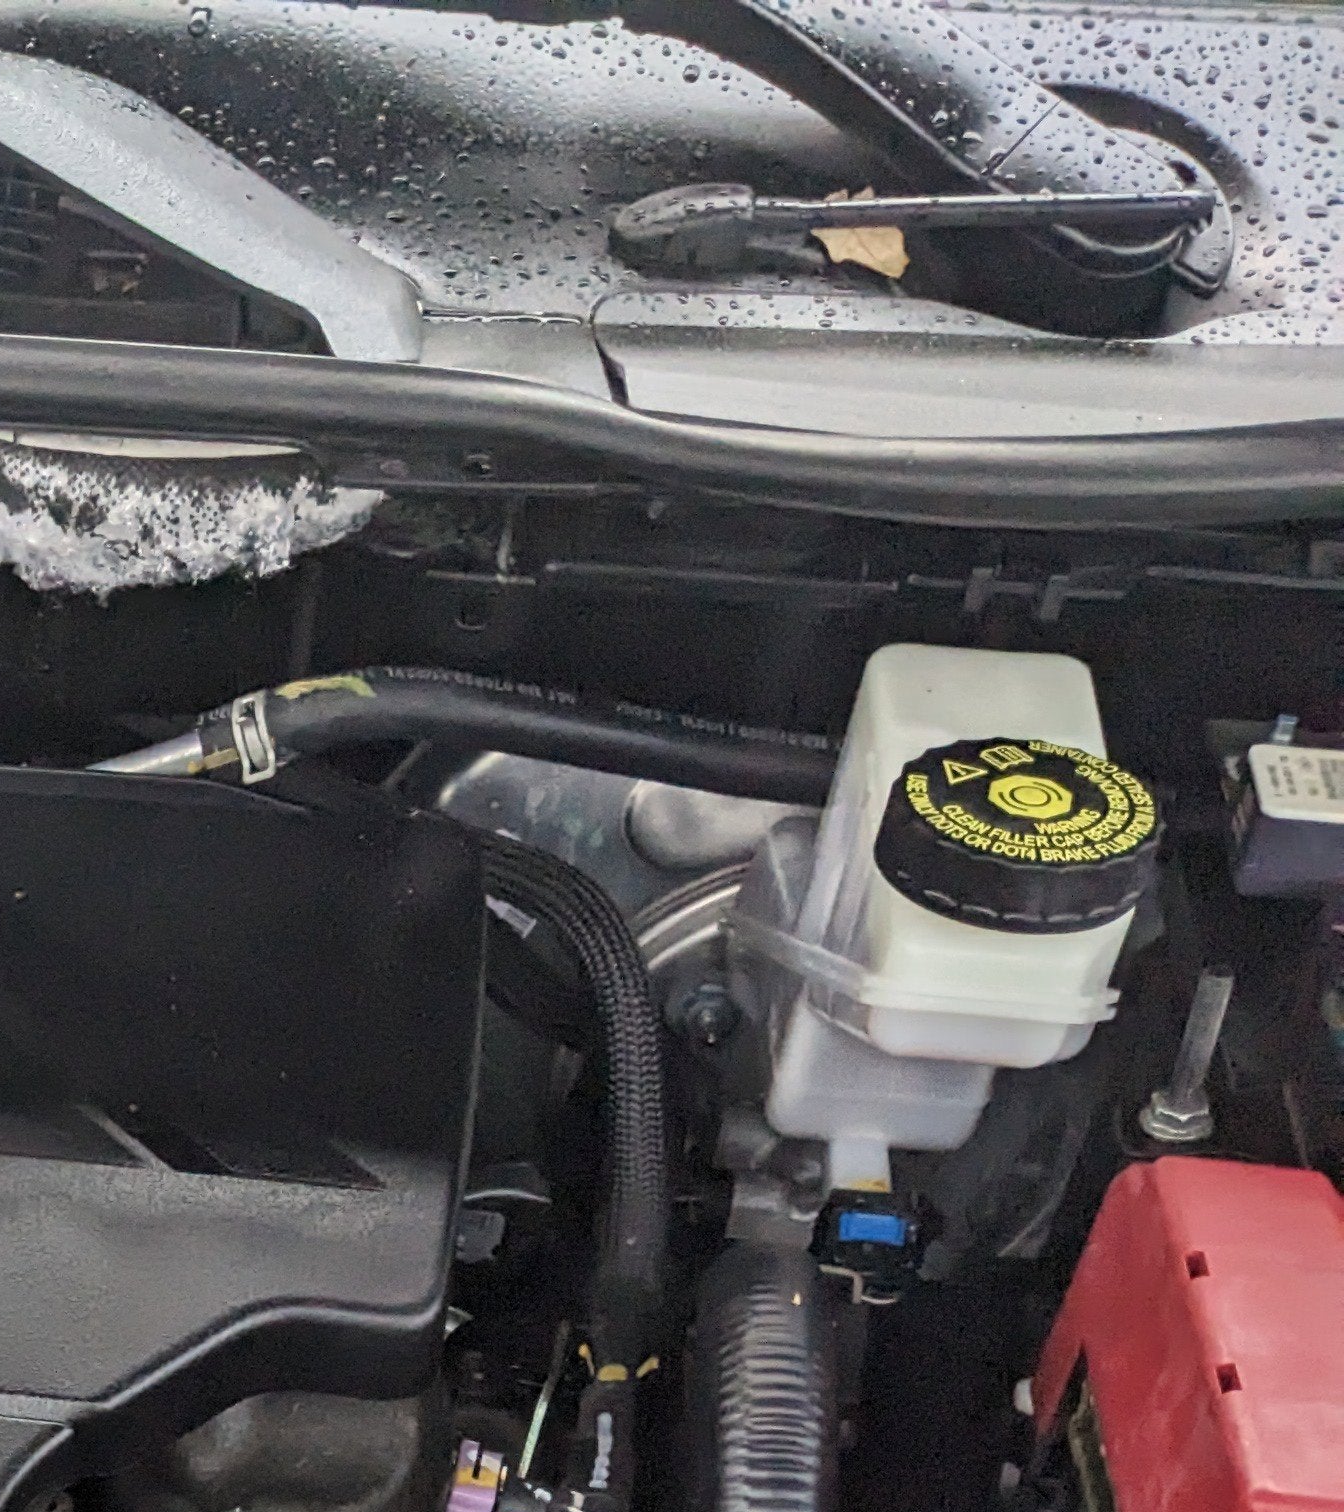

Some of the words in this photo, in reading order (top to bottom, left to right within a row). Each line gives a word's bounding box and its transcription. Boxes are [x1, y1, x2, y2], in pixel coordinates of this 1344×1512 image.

[1029, 741, 1119, 773] CONTAINER
[925, 813, 968, 839] DOT3
[942, 804, 992, 835] CLEAN
[988, 827, 1050, 848] FILLER
[1051, 833, 1085, 848] CAP
[1083, 809, 1130, 841] BEFORE
[1034, 808, 1101, 834] WARNING
[963, 833, 991, 850] OR
[992, 841, 1037, 861] DOT4
[1040, 846, 1101, 862] BRAKE
[1095, 833, 1138, 857] FLUID
